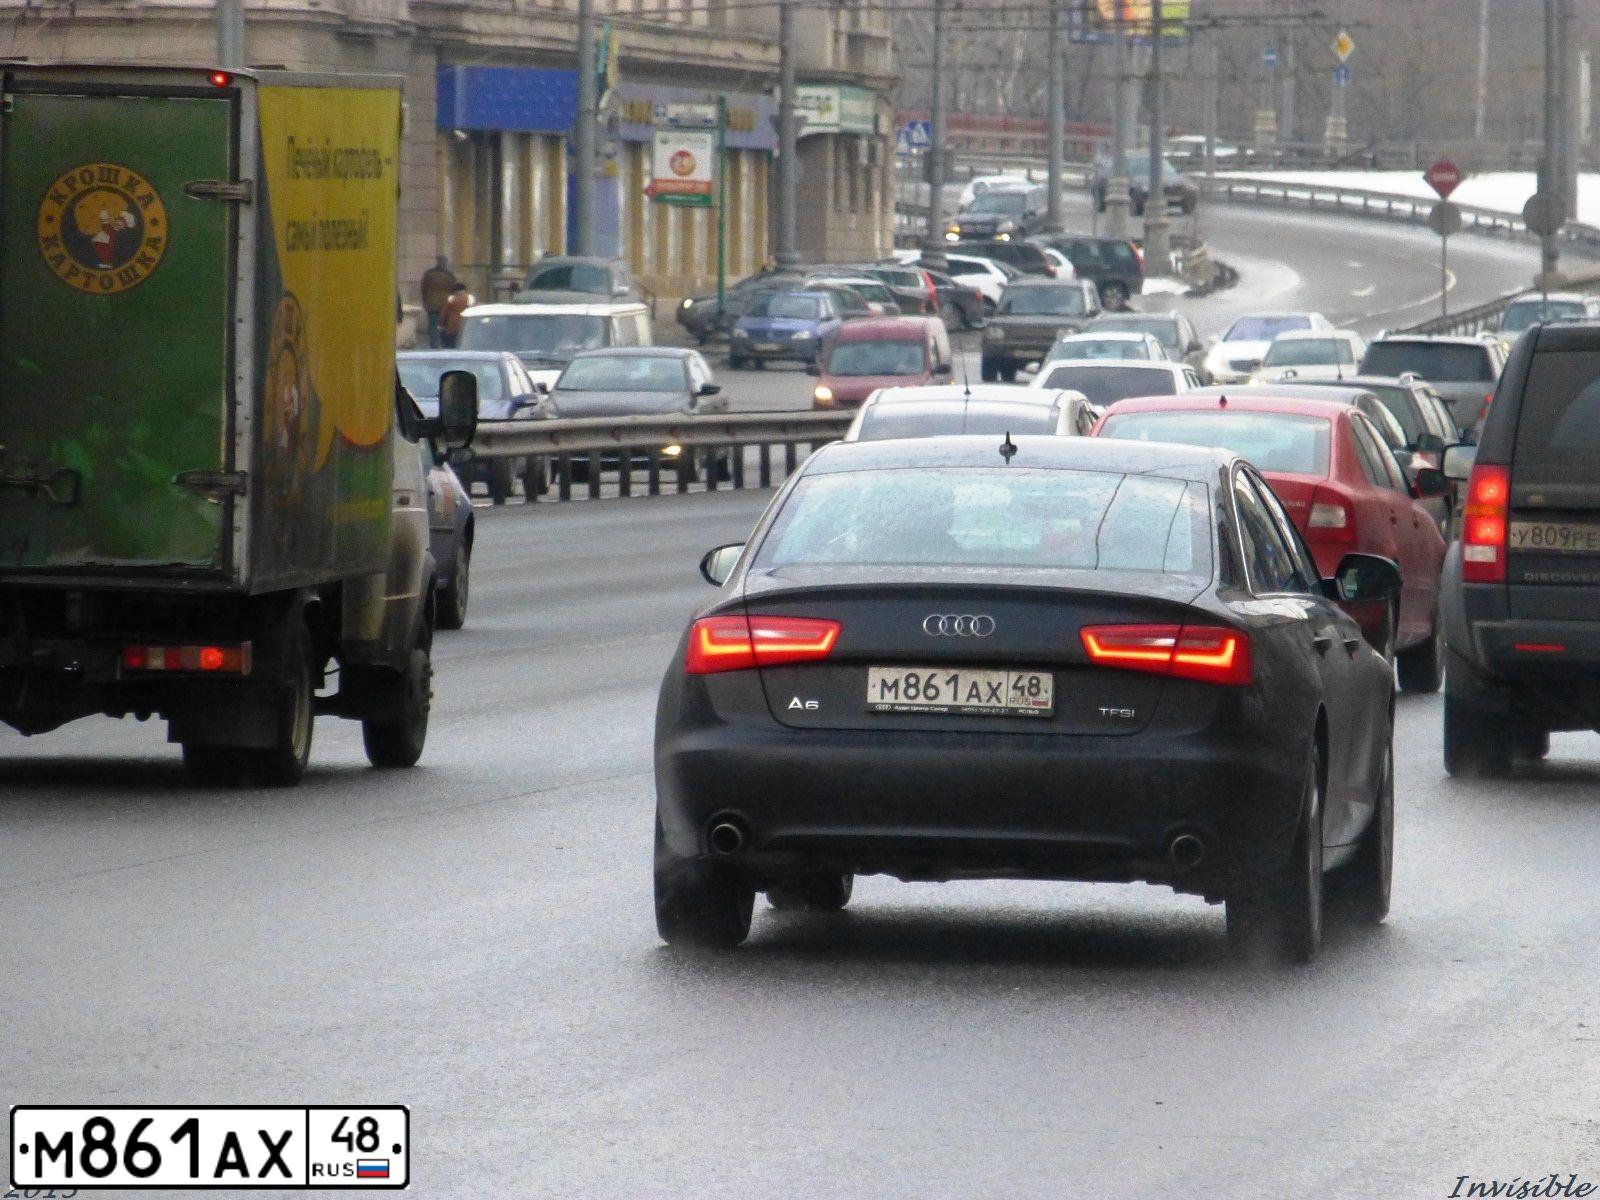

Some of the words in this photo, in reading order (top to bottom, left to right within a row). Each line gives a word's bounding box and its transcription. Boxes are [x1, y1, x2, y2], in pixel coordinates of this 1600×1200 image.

[48, 165, 156, 208] КРОШКА
[42, 235, 162, 290] КАРТОШКА
[880, 672, 1003, 703] М861АХ
[1011, 674, 1041, 697] 48
[788, 696, 819, 710] A6
[1009, 697, 1032, 706] RUS
[1098, 708, 1135, 718] TFSI
